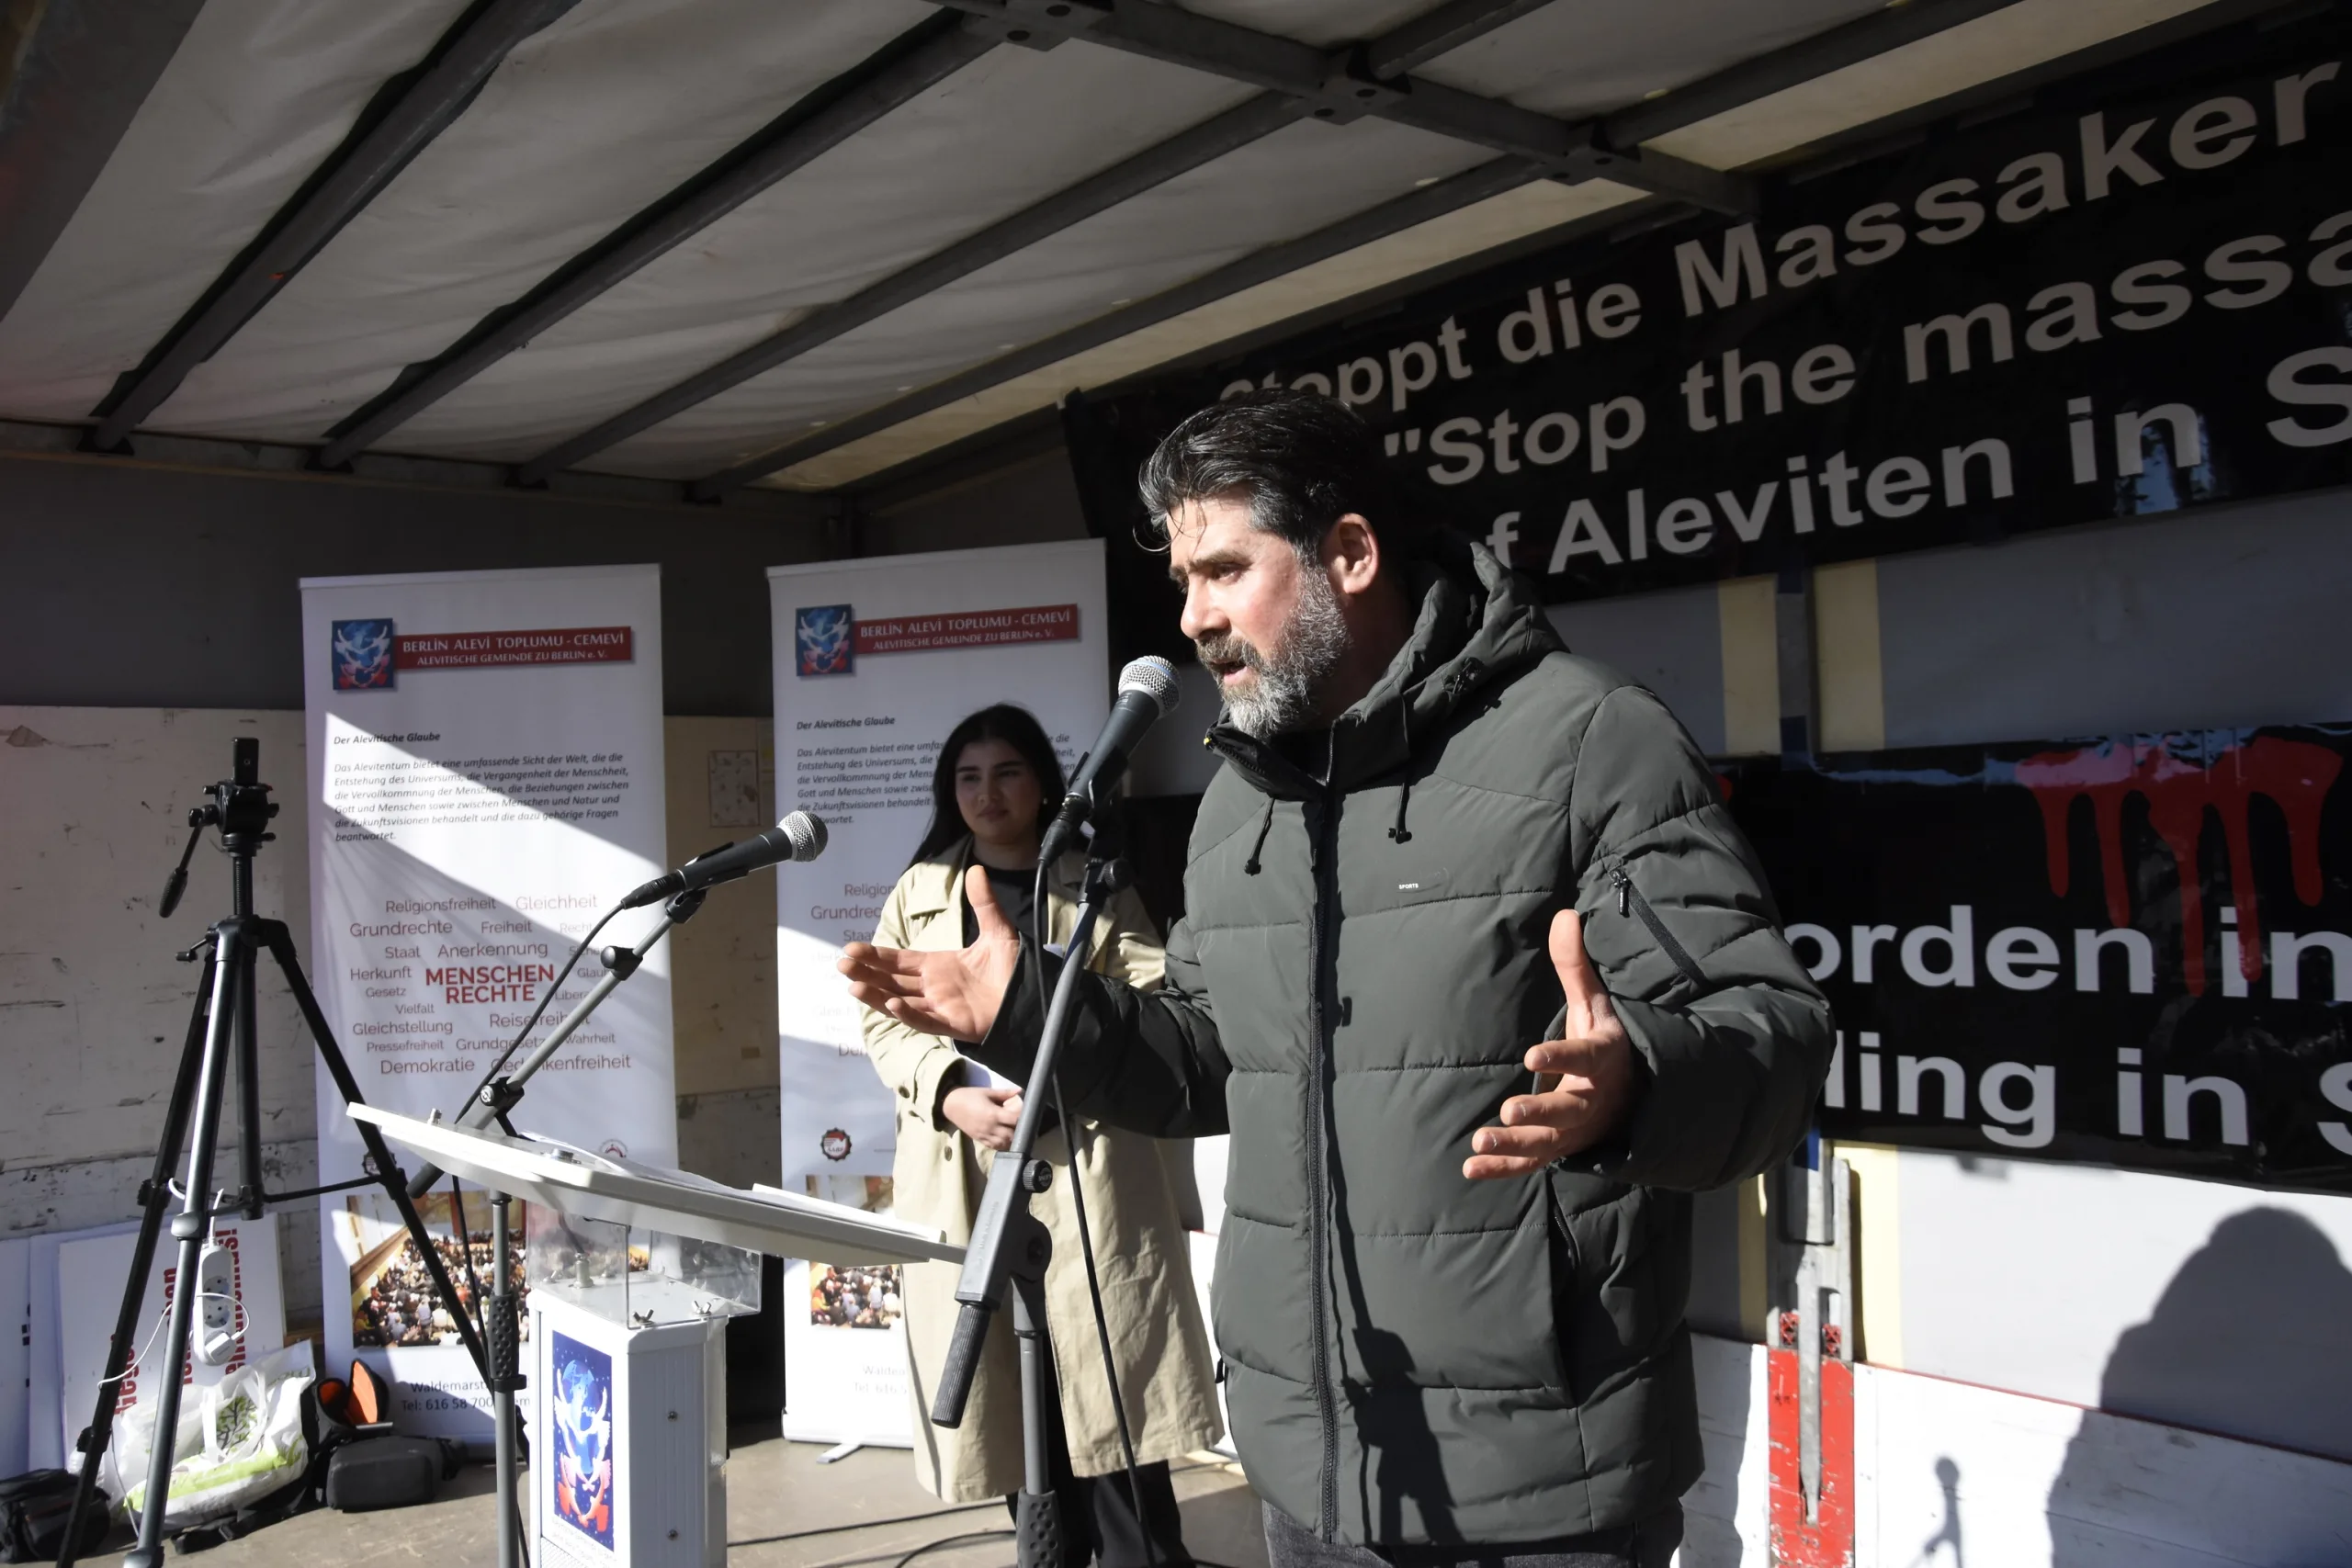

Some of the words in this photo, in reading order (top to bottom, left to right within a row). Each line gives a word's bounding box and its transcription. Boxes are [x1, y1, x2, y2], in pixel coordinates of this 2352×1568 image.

[1498, 277, 1642, 364] die
[1674, 61, 2343, 318] Massaker
[1385, 395, 1646, 486] "Stop
[1680, 343, 1857, 433] the
[1547, 437, 2014, 574] Aleviten
[2067, 395, 2202, 486] in
[947, 615, 1012, 631] TOPLUMU
[495, 635, 563, 649] TOPLUMU
[933, 634, 982, 646] GEMEINDE
[984, 633, 998, 642] ZU
[1000, 630, 1034, 640] BERLIN
[417, 654, 479, 666] ALEVITISCHE
[480, 652, 533, 663] GEMEINDE
[535, 651, 549, 661] ZU
[551, 650, 585, 660] BERLIN
[797, 721, 812, 730] Der
[814, 717, 862, 729] Alevitische
[864, 716, 895, 726] Glaube
[334, 736, 351, 745] Der
[353, 733, 404, 744] Alevitische
[407, 731, 441, 742] Glaube
[797, 749, 813, 758] Das
[815, 745, 868, 757] Alevitentum
[870, 743, 895, 753] bietet
[897, 741, 915, 751] eine
[334, 764, 351, 773] Das
[354, 761, 411, 773] Alevitentum
[413, 760, 439, 770] bietet
[442, 759, 461, 768] eine
[464, 756, 519, 768] umfassende
[523, 755, 545, 765] Sicht
[548, 755, 562, 764] der
[565, 753, 589, 764] Welt,
[592, 753, 606, 762] die
[608, 752, 623, 762] die
[797, 760, 845, 772] Entstehung
[847, 759, 863, 769] des
[920, 755, 933, 764] die
[334, 775, 386, 787] Entstehung
[389, 775, 405, 784] des
[408, 773, 464, 784] Universums,
[467, 772, 481, 782] die
[483, 769, 552, 782] Vergangenheit
[554, 769, 571, 779] der
[572, 767, 628, 778] Menschheit,
[797, 775, 810, 784] die
[813, 772, 890, 784] Vervollkommnung
[892, 771, 907, 780] der
[334, 791, 349, 800] die
[351, 788, 435, 800] Vervollkommnung
[437, 787, 453, 796] der
[456, 784, 505, 795] Menschen,
[508, 784, 523, 794] die
[525, 782, 584, 794] Beziehungen
[586, 781, 628, 791] zwischen
[797, 789, 817, 798] Gott
[819, 788, 835, 797] und
[837, 785, 882, 796] Menschen
[884, 784, 909, 794] sowie
[335, 805, 355, 814] Gott
[357, 804, 376, 813] und
[378, 802, 426, 813] Menschen
[429, 801, 455, 810] sowie
[458, 799, 499, 809] zwischen
[502, 796, 549, 807] Menschen
[552, 795, 570, 806] und
[572, 795, 599, 806] Natur
[601, 794, 619, 804] und
[813, 799, 885, 812] Zukunftsvisionen
[887, 796, 931, 808] behandelt
[335, 819, 349, 829] die
[351, 817, 429, 829] Zukunftsvisionen
[432, 814, 478, 824] behandelt
[481, 813, 498, 822] und
[501, 812, 514, 821] die
[517, 811, 540, 820] dazu
[543, 809, 583, 821] gehörige
[586, 808, 618, 819] Fragen
[335, 830, 396, 842] beantwortet.
[386, 897, 497, 915] Religionsfreiheit
[515, 894, 598, 910] Gleichheit
[349, 919, 453, 938] Grundrechte
[481, 920, 533, 933] Freiheit
[560, 922, 593, 933] Recht
[385, 946, 421, 959] Staat
[437, 942, 548, 958] Anerkennung
[2220, 906, 2352, 1001] in
[350, 966, 412, 980] Herkunft
[425, 964, 555, 987] MENSCHEN
[366, 987, 407, 998] Gesetz
[446, 985, 536, 1005] RECHTE
[395, 1003, 435, 1015] Vielfalt
[353, 1021, 453, 1036] Gleichstellung
[367, 1040, 445, 1053] Pressefreiheit
[565, 1032, 616, 1045] Wahrheit
[380, 1057, 475, 1075] Demokratie
[2117, 1047, 2249, 1146] in
[401, 1399, 422, 1411] Tel:
[425, 1398, 449, 1410] 616
[452, 1397, 468, 1410] 58
